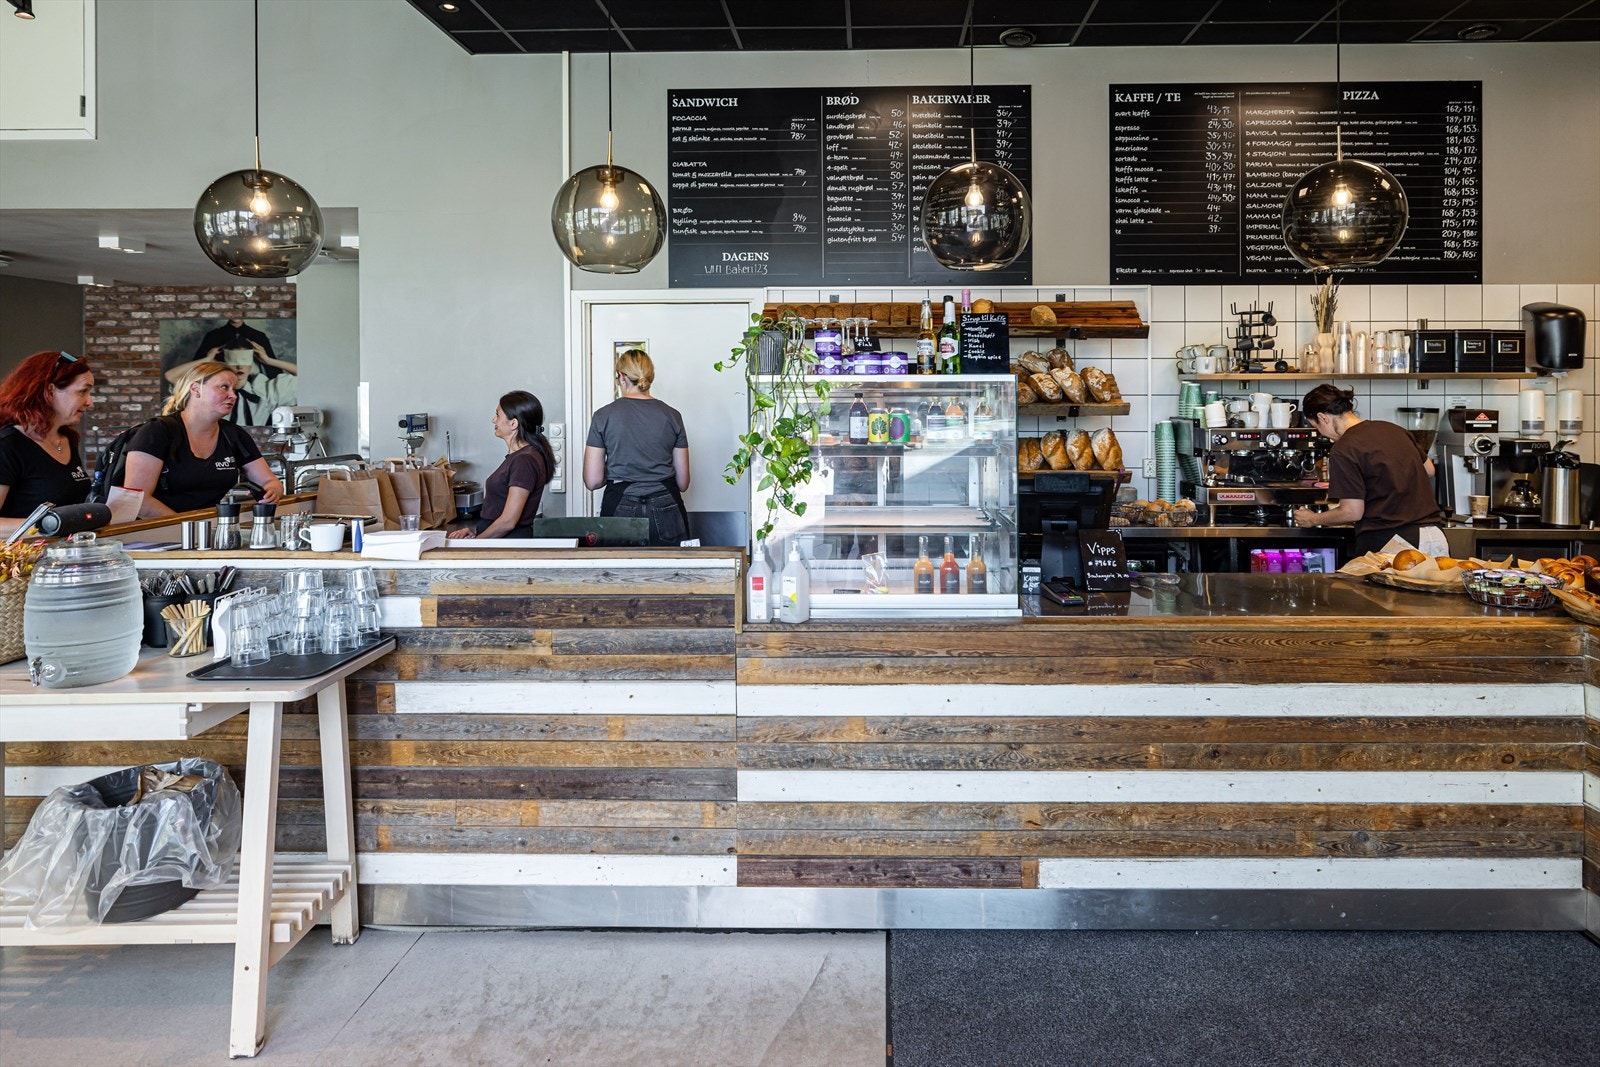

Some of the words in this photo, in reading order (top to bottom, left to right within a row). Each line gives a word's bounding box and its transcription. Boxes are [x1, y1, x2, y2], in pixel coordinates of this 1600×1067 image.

[1115, 93, 1154, 102] KAFFE
[1165, 92, 1181, 102] TE
[1343, 91, 1380, 100] PIZZA
[672, 98, 738, 108] SANDWICH
[826, 96, 860, 106] BRØD
[1132, 110, 1150, 118] kaffe
[1116, 176, 1132, 184] kaffe
[1116, 186, 1138, 194] iskaffe
[1134, 207, 1162, 216] sjokolade
[672, 217, 698, 226] kylling
[827, 226, 864, 234] rundstykke
[827, 236, 861, 244] glutenfritt
[722, 252, 770, 262] DAGENS
[1086, 542, 1116, 556] Vipps
